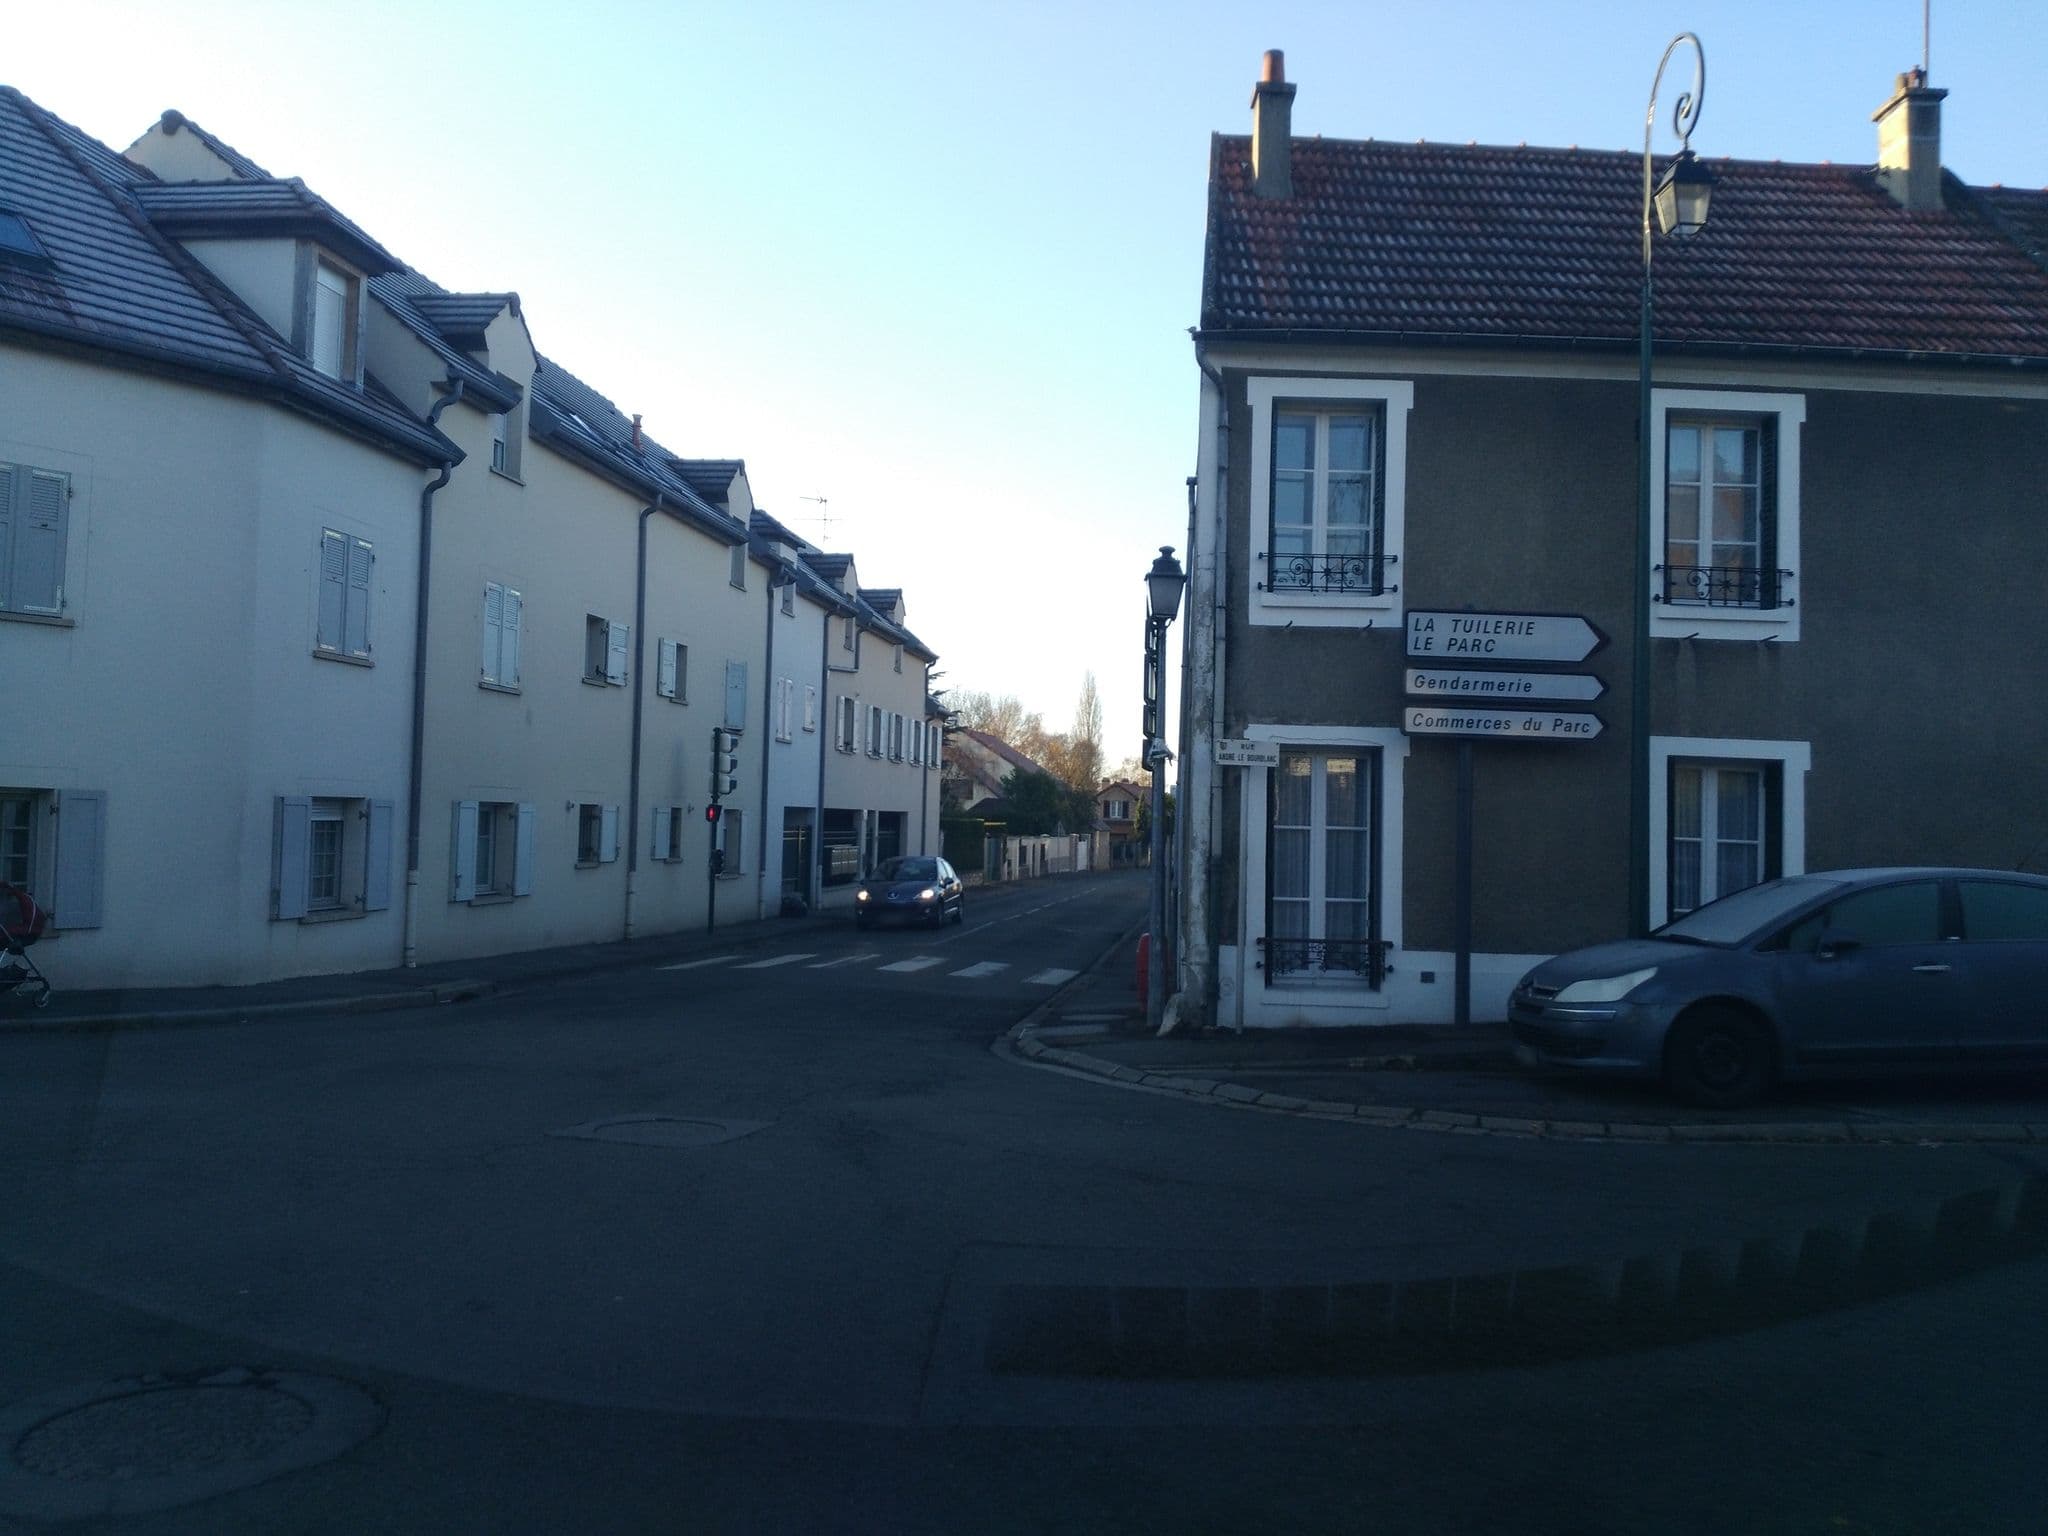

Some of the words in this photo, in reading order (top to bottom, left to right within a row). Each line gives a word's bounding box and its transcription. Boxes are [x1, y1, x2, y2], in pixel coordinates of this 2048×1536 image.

[1414, 618, 1435, 632] LA
[1452, 619, 1536, 635] TUILERIE
[1413, 637, 1434, 651] LE
[1447, 638, 1496, 653] PARC
[1414, 675, 1533, 693] Gendarmerie
[1413, 713, 1511, 730] Commerces
[1523, 717, 1542, 731] du
[1552, 718, 1591, 734] Parc
